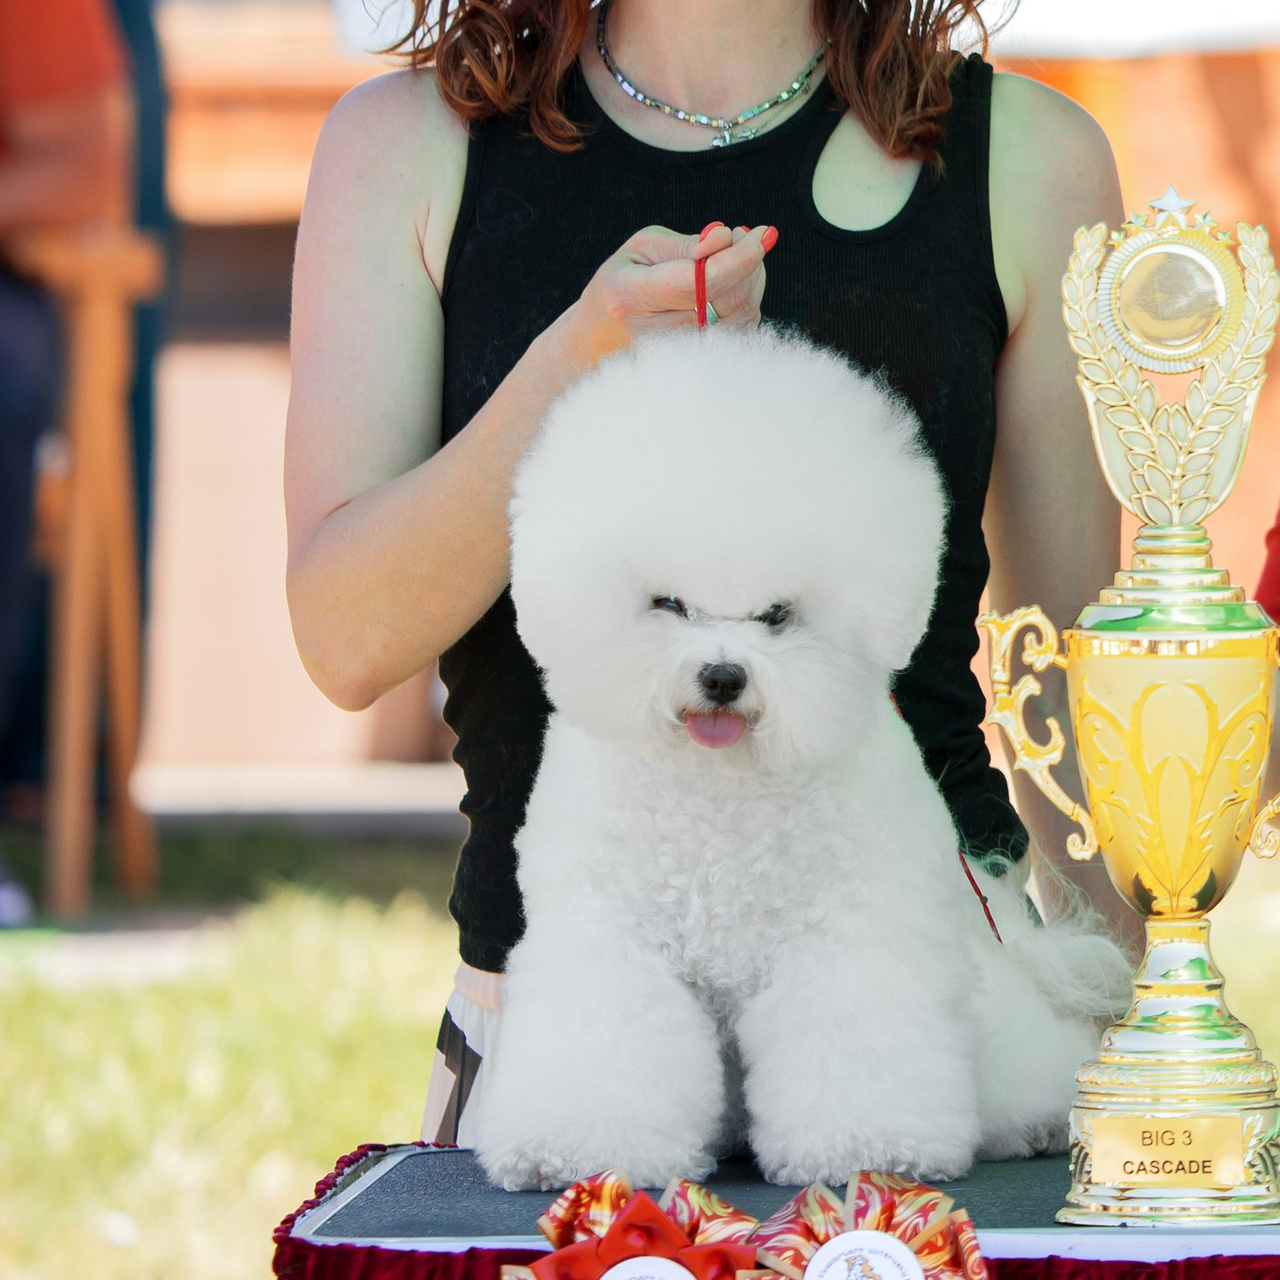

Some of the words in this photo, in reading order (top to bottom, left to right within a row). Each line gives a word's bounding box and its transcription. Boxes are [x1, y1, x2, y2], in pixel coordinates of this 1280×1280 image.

[1141, 1130, 1175, 1147] BIG
[1182, 1130, 1193, 1147] 3
[1122, 1159, 1213, 1175] CASCADE
